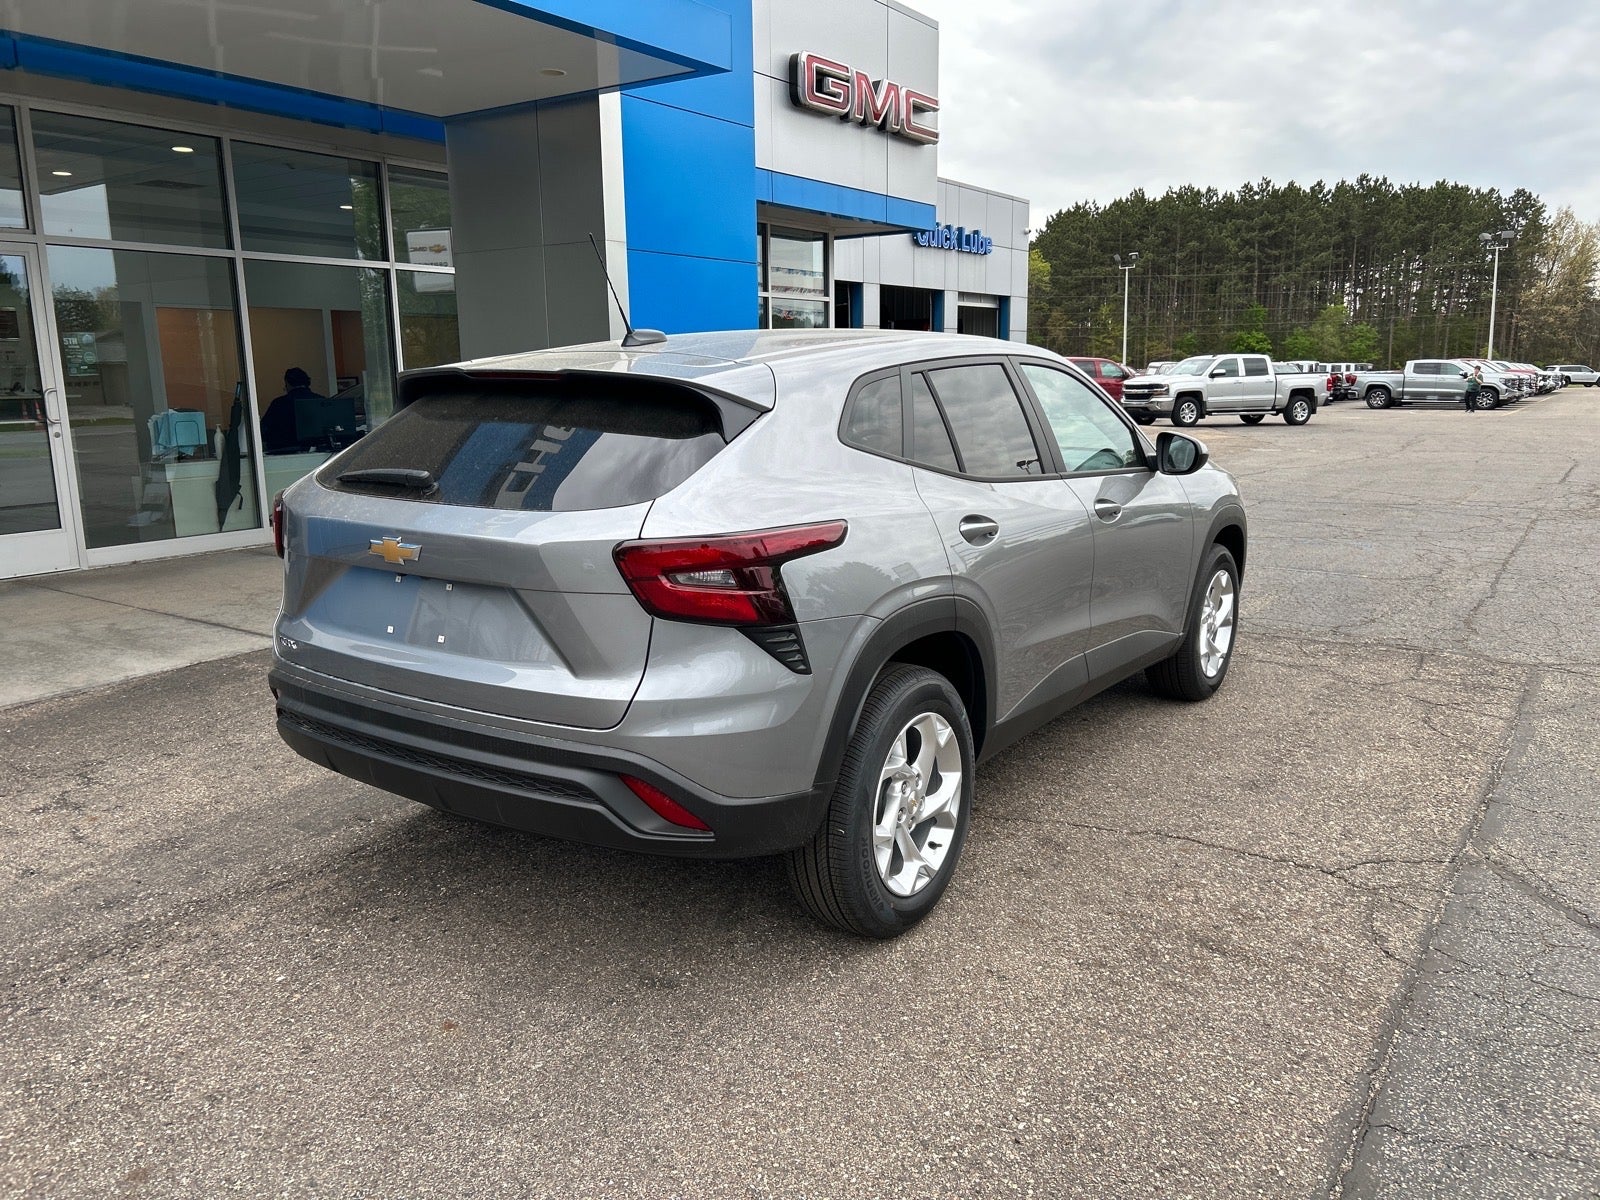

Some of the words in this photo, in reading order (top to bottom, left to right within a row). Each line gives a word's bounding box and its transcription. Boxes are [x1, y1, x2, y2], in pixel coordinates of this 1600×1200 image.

[793, 50, 940, 145] GMC
[915, 223, 958, 251] Quick
[960, 227, 993, 255] Lube
